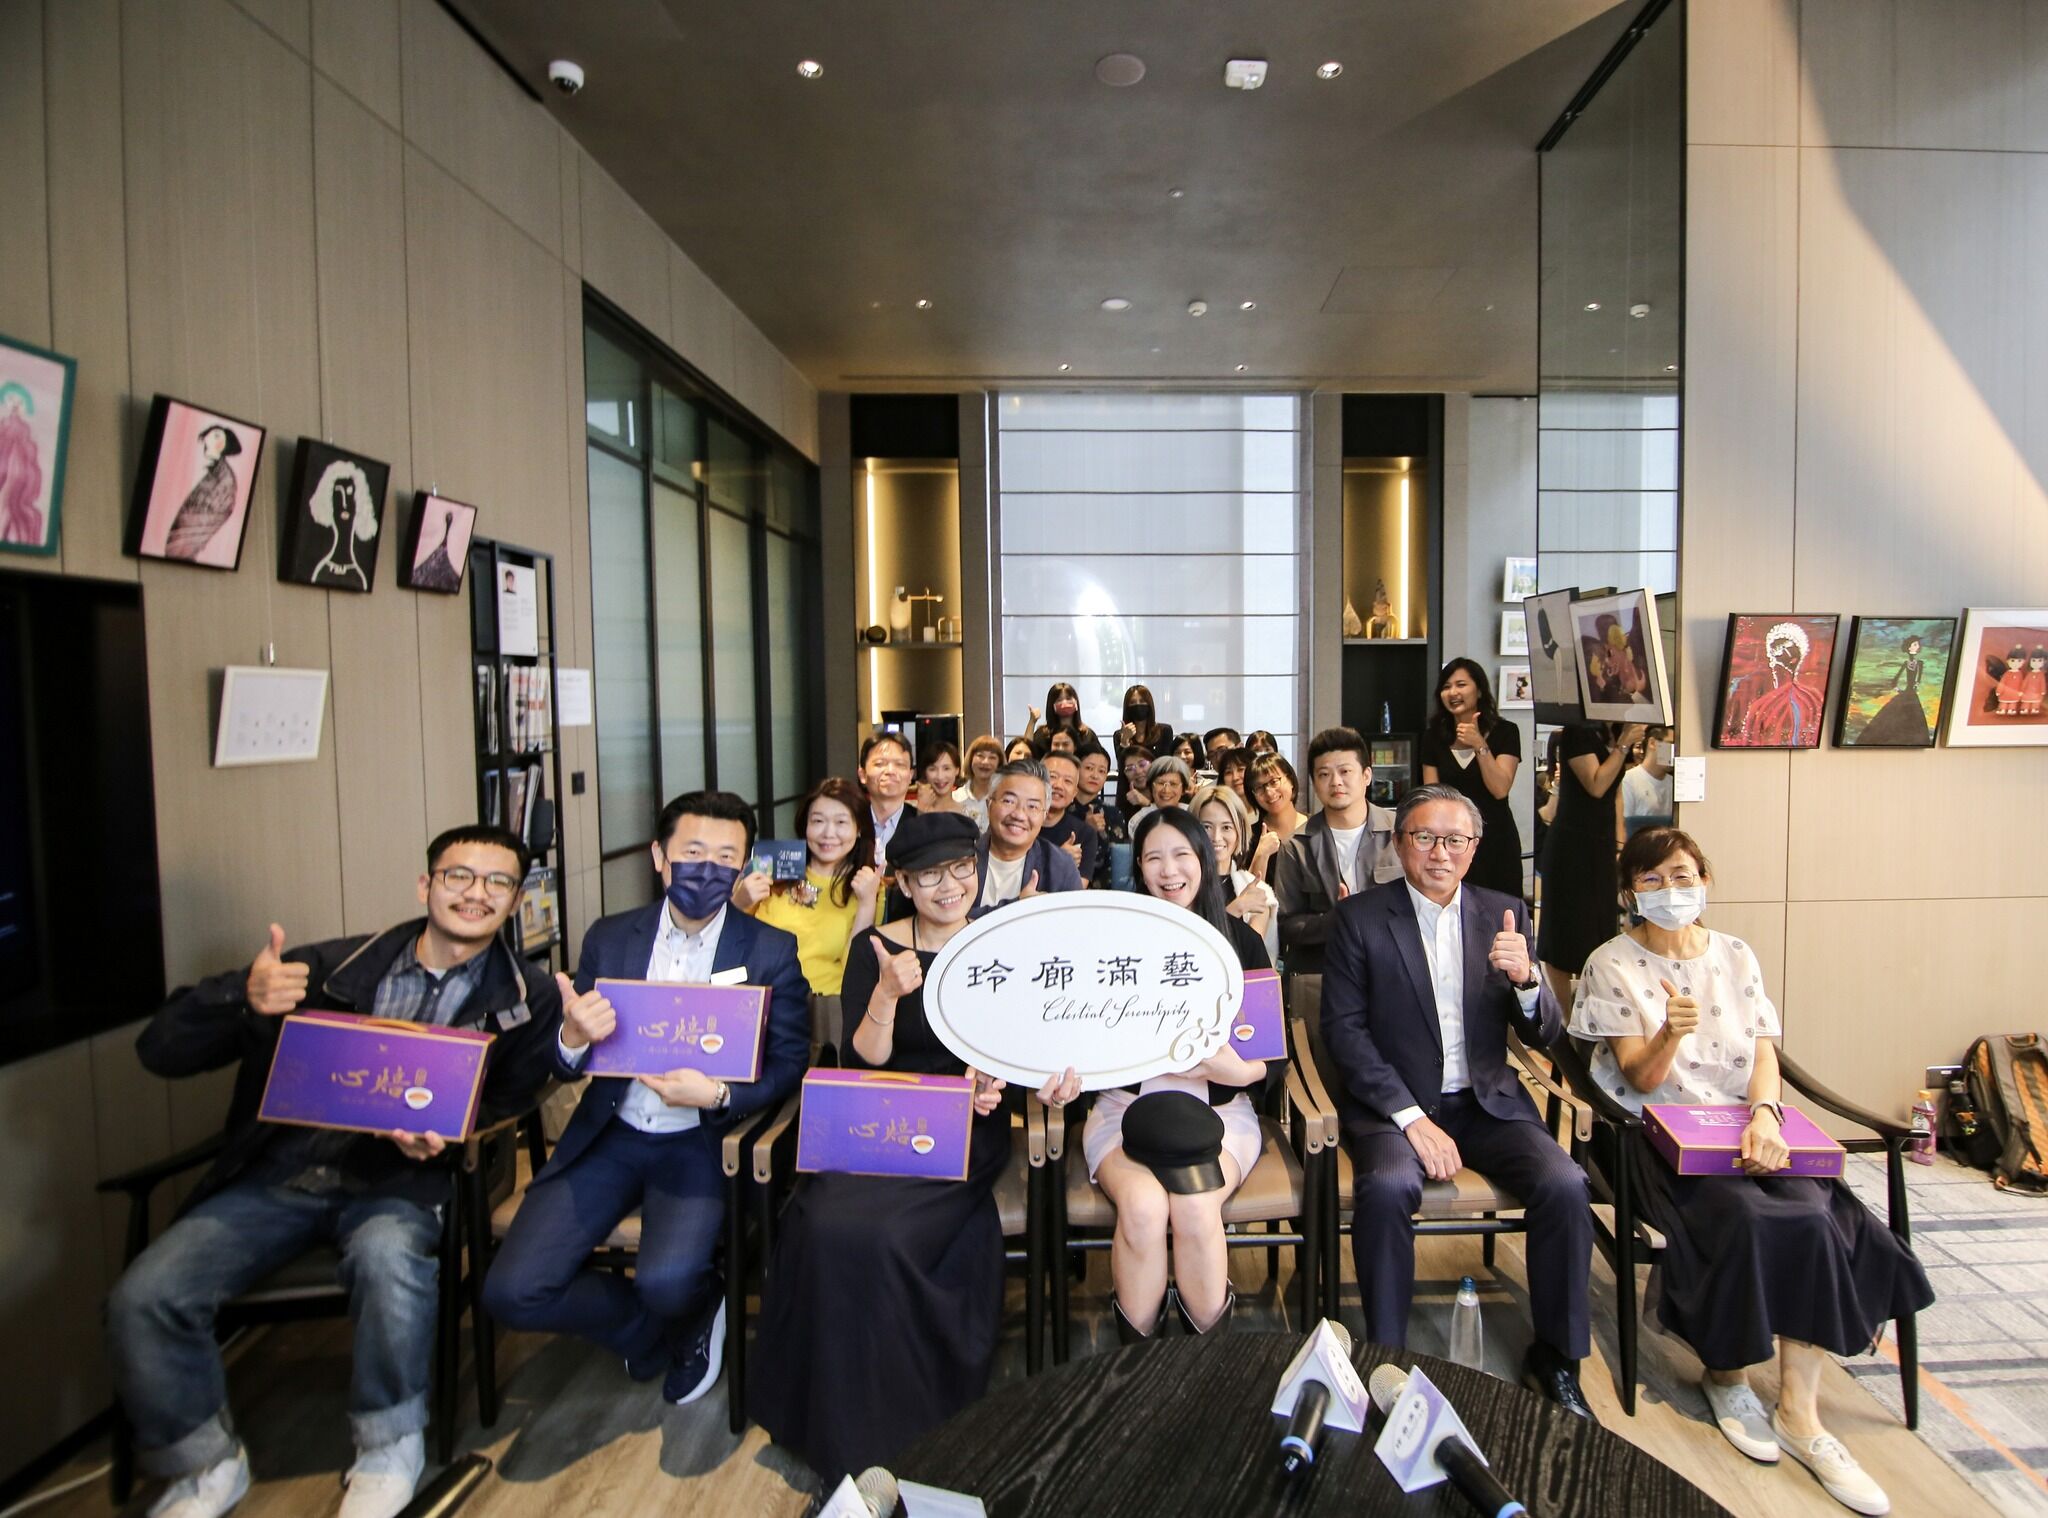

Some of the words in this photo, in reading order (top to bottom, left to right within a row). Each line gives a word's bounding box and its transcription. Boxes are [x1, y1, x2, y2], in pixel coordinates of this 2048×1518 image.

[967, 951, 1204, 993] 玲廊滿藝
[1042, 996, 1112, 1022] Celestial
[1104, 994, 1191, 1036] Serendipity
